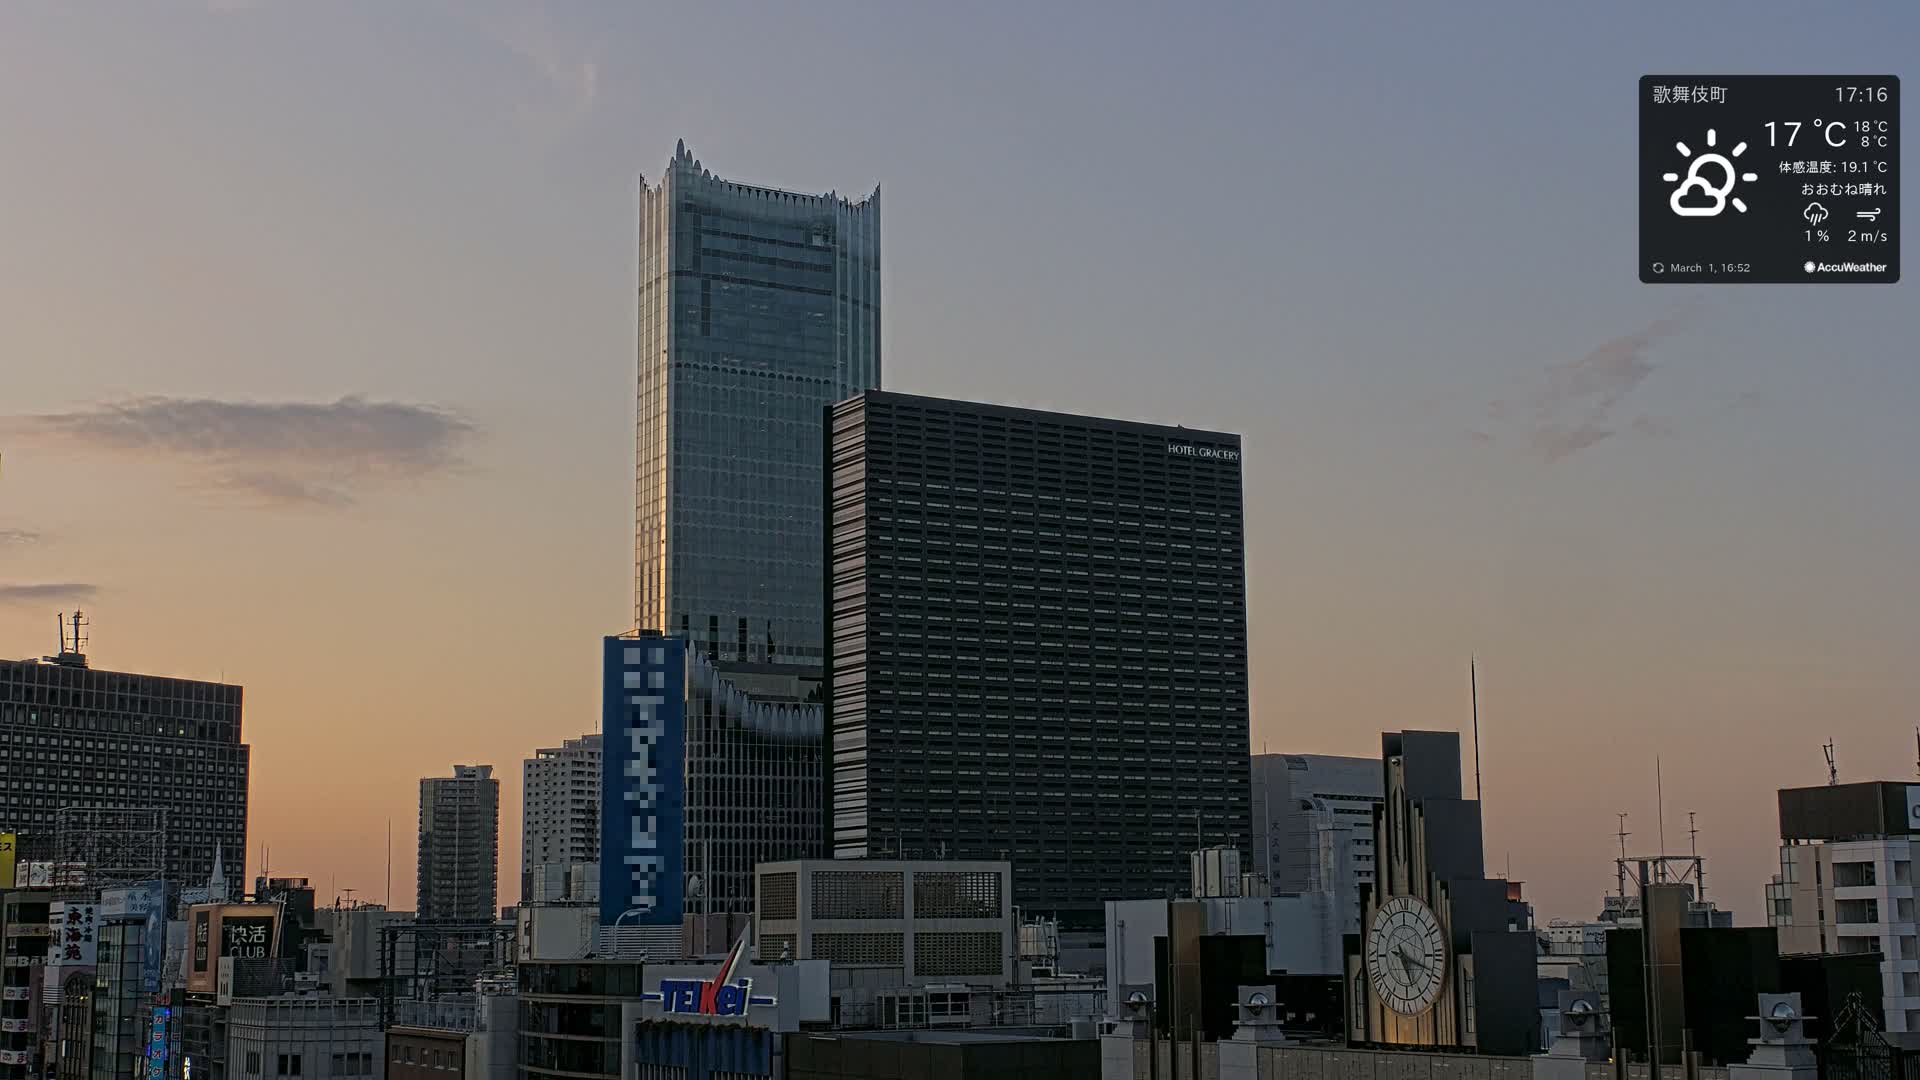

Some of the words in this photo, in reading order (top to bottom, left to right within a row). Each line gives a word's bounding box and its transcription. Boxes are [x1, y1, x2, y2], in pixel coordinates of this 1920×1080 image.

[1167, 444, 1197, 456] HOTEL
[1198, 447, 1239, 461] GRACERY
[65, 907, 83, 960] 東海苑
[231, 925, 266, 943] 快活
[231, 946, 265, 958] CLUB
